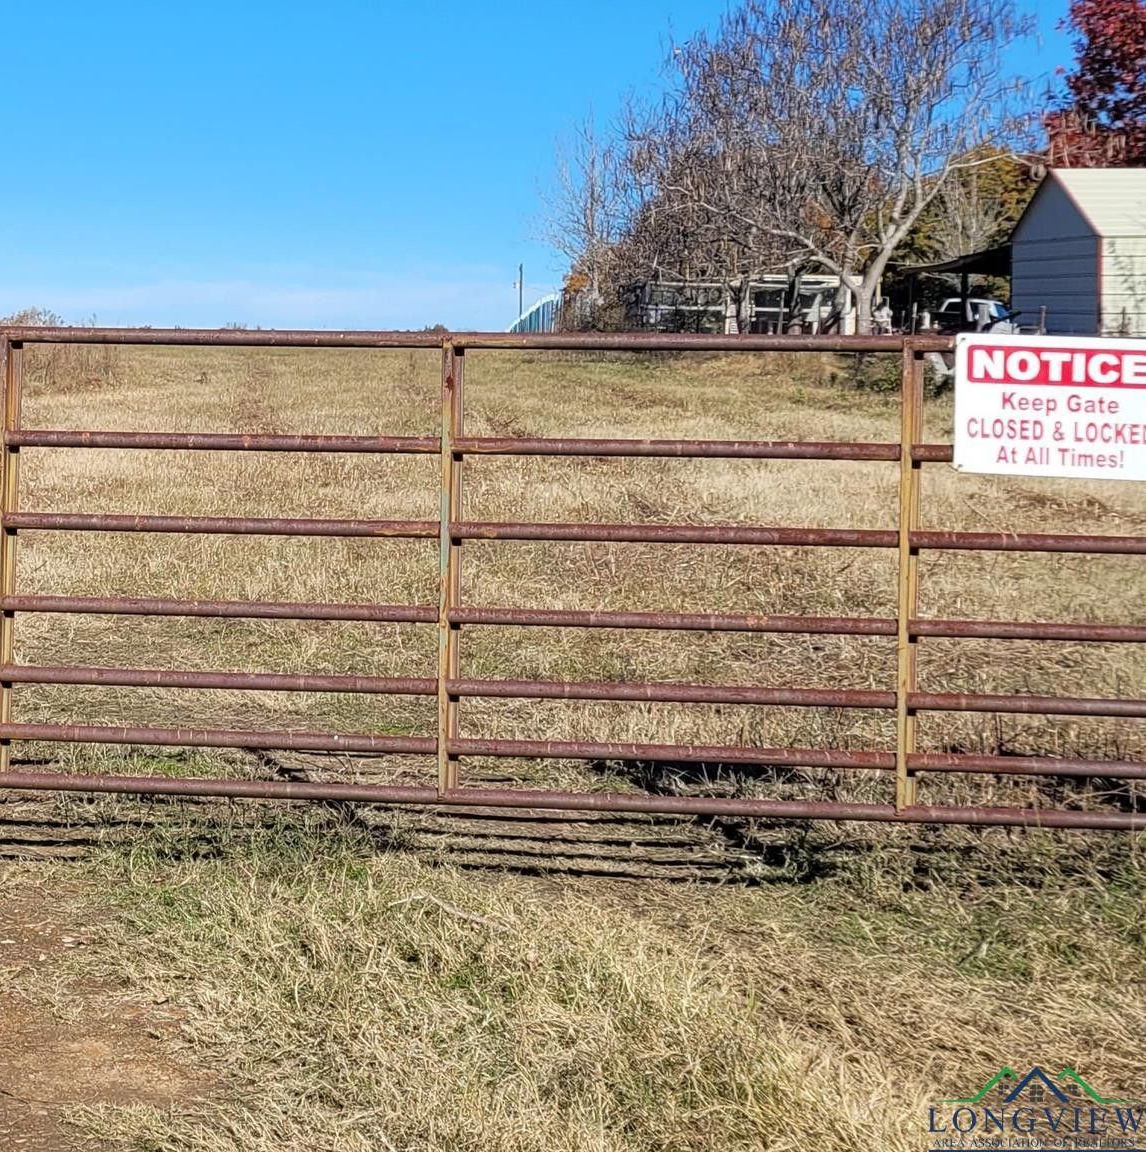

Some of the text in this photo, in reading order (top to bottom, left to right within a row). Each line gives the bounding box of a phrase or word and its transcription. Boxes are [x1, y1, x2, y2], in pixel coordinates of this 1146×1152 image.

[971, 349, 1146, 384] NOTICE
[1002, 392, 1120, 416] Keep Gate
[967, 418, 1044, 440] CLOSED
[1053, 421, 1065, 441] &
[996, 446, 1124, 468] At All Times!
